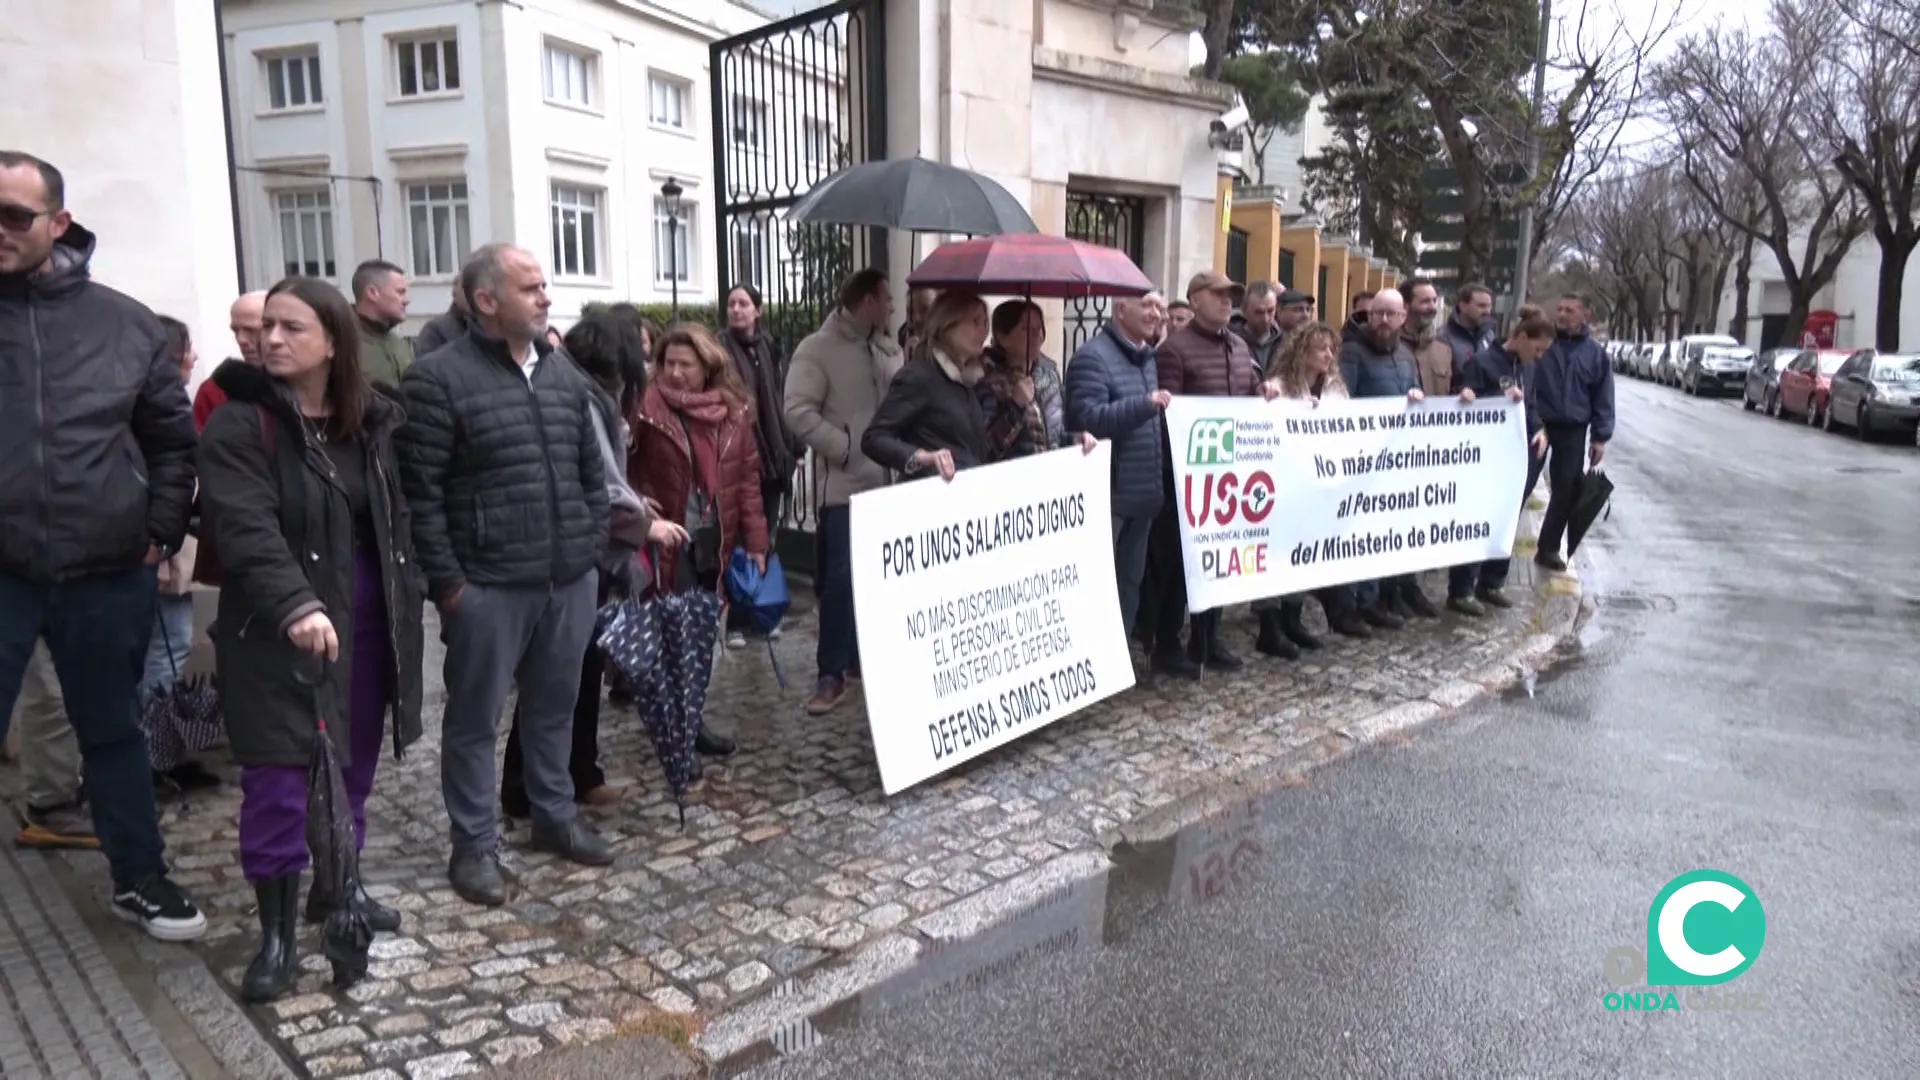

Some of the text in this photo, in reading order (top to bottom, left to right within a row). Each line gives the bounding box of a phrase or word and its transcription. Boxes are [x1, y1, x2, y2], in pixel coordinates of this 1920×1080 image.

[1286, 409, 1506, 434] EN DEFENSA DE UNOS SALARIOS DIGNOS
[1314, 440, 1481, 479] No más discriminación
[1185, 469, 1275, 529] USO
[1337, 481, 1456, 519] al Personal Civil
[882, 492, 1084, 580] POR UNOS SALARIOS DIGNOS
[1202, 543, 1267, 579] PLAGE
[1291, 519, 1490, 566] del Ministerio de Defensa
[907, 563, 1079, 641] NO MÁS DISCRIMINACIÓN PARA
[933, 599, 1065, 667] EL PERSONAL CIVIL DEL
[933, 625, 1073, 700] MINISTERIO DE DEFENSA
[928, 658, 1096, 760] DEFENSA SOMOS TODOS
